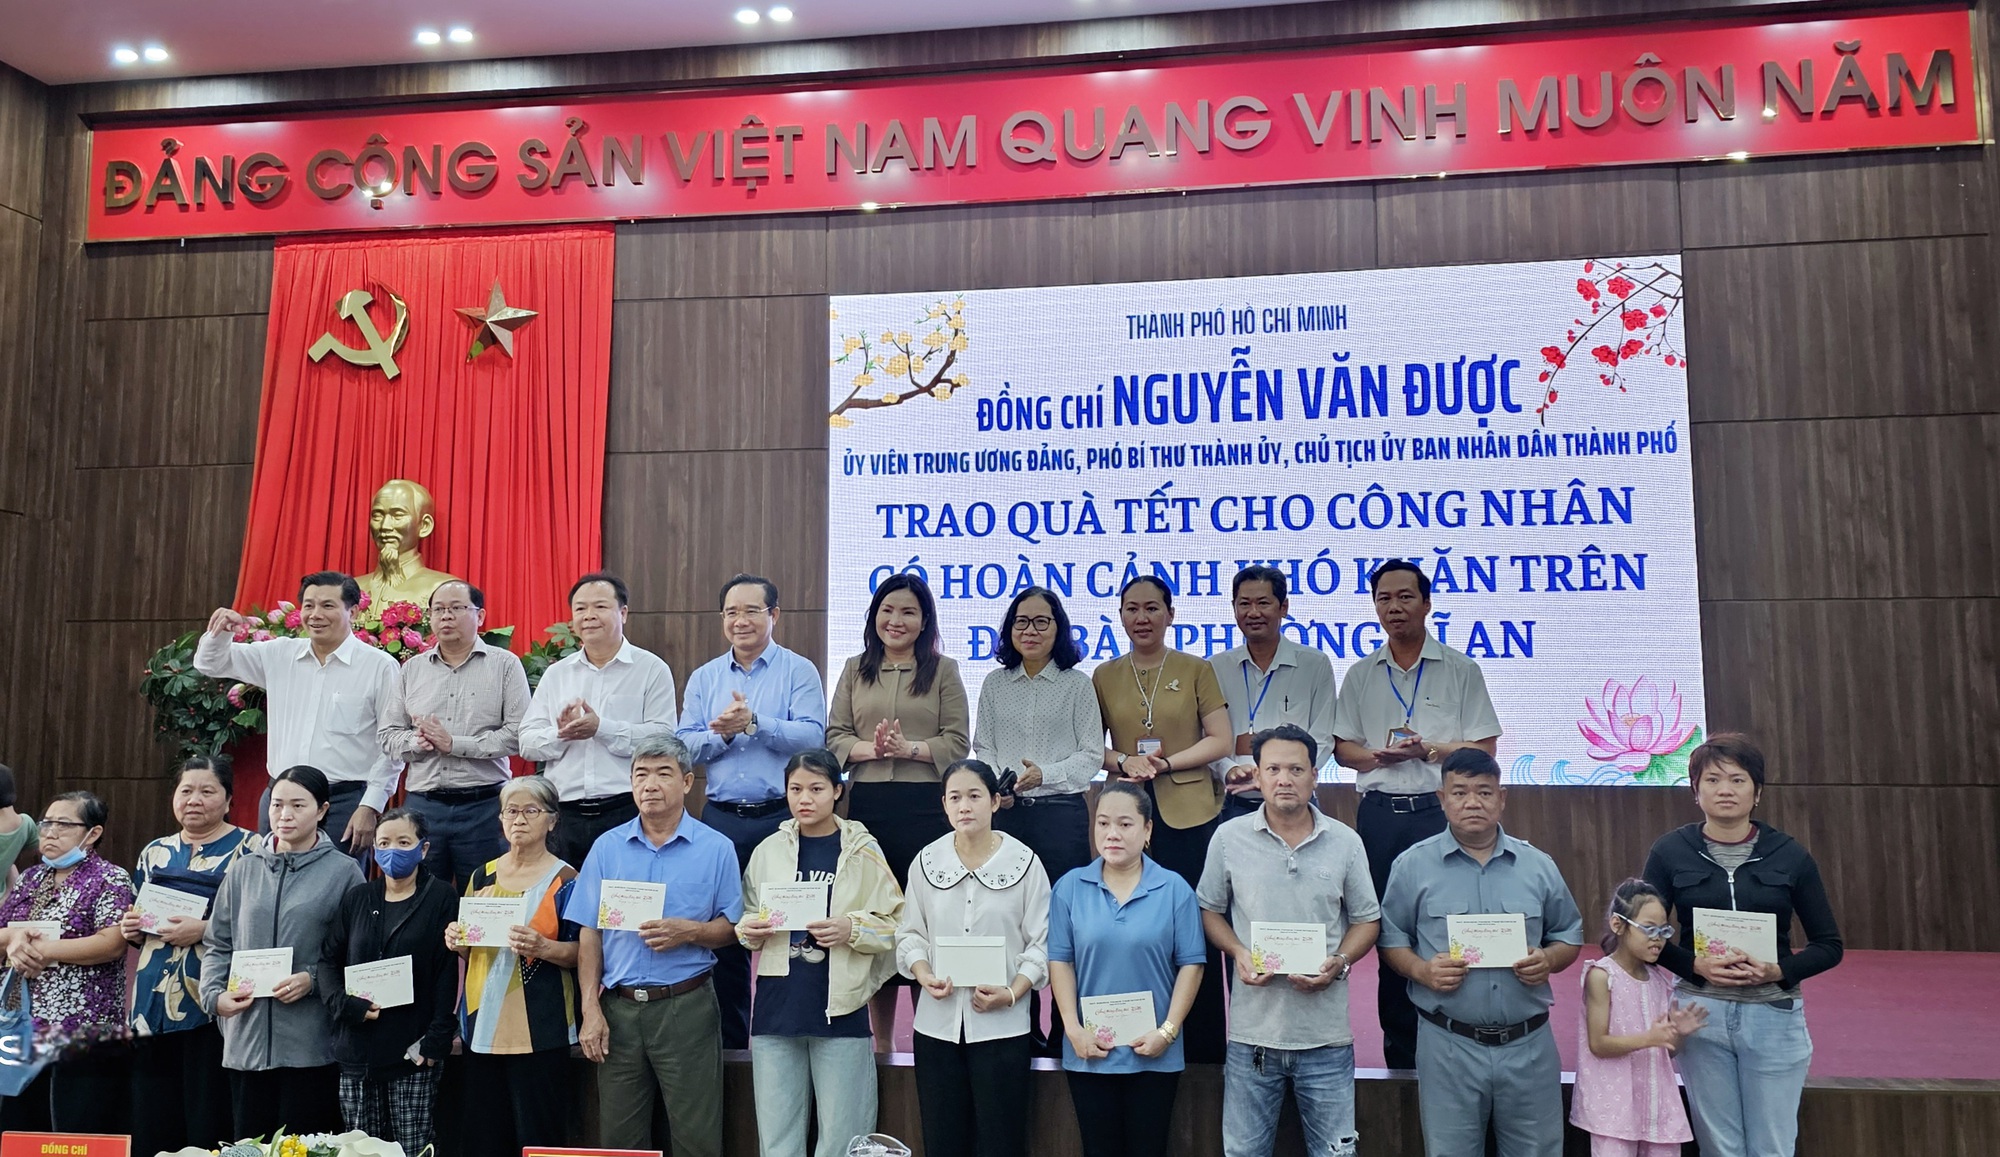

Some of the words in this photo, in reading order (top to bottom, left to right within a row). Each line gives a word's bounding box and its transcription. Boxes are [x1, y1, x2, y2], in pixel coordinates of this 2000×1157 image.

[104, 137, 287, 210] ĐẢNG
[306, 134, 497, 210] CỘNG
[517, 117, 643, 189] SẢN
[665, 115, 803, 190] VIỆT
[826, 115, 978, 174] NAM
[1001, 96, 1271, 163] QUANG
[1293, 83, 1468, 145] VINH
[1498, 52, 1735, 133] MUÔN
[1761, 40, 1955, 117] NĂM
[1126, 309, 1184, 339] THÀNH
[1191, 302, 1225, 336] PHỐ
[1232, 301, 1256, 335] HỒ
[1262, 303, 1292, 333] CHÍ
[1298, 304, 1347, 331] MINH
[976, 382, 1051, 431] ĐỒNG
[1061, 385, 1103, 429] CHÍ
[1113, 346, 1283, 426] NGUYỄN
[1298, 351, 1388, 420] VĂN
[1402, 354, 1522, 427] ĐƯỢC
[844, 448, 865, 476] ỦY
[871, 449, 908, 475] VIÊN
[914, 452, 970, 474] TRUNG
[975, 449, 1022, 472] ƯƠNG
[1027, 443, 1081, 475] ĐẢNG,
[1087, 441, 1122, 469] PHÓ
[1128, 440, 1145, 468] BÍ
[1150, 442, 1186, 467] THƯ
[1191, 438, 1252, 466] THÀNH
[1258, 435, 1289, 468] ỦY,
[1295, 433, 1330, 463] CHỦ
[1335, 439, 1376, 468] TỊCH
[1382, 431, 1406, 461] ỦY
[1413, 437, 1450, 460] BAN
[1457, 430, 1511, 459] NHÂN
[1517, 429, 1557, 457] DÂN
[1563, 426, 1631, 456] THÀNH
[1637, 420, 1677, 453] PHỐ
[877, 501, 996, 538] TRAO
[1008, 491, 1106, 544] QUÀ
[1115, 481, 1200, 534] TẾT
[1210, 494, 1314, 533] CHO
[1327, 483, 1468, 530] CÔNG
[1481, 477, 1635, 529] NHÂN
[940, 553, 1076, 599] HOÀN
[1086, 551, 1222, 598] CẢNH
[1234, 547, 1340, 595] HÓ
[1353, 546, 1499, 594] KĂN
[1510, 544, 1648, 592] TRÊN
[1071, 614, 1134, 660] BÀ
[1172, 614, 1384, 660] PHỜNG
[1465, 621, 1536, 658] AN
